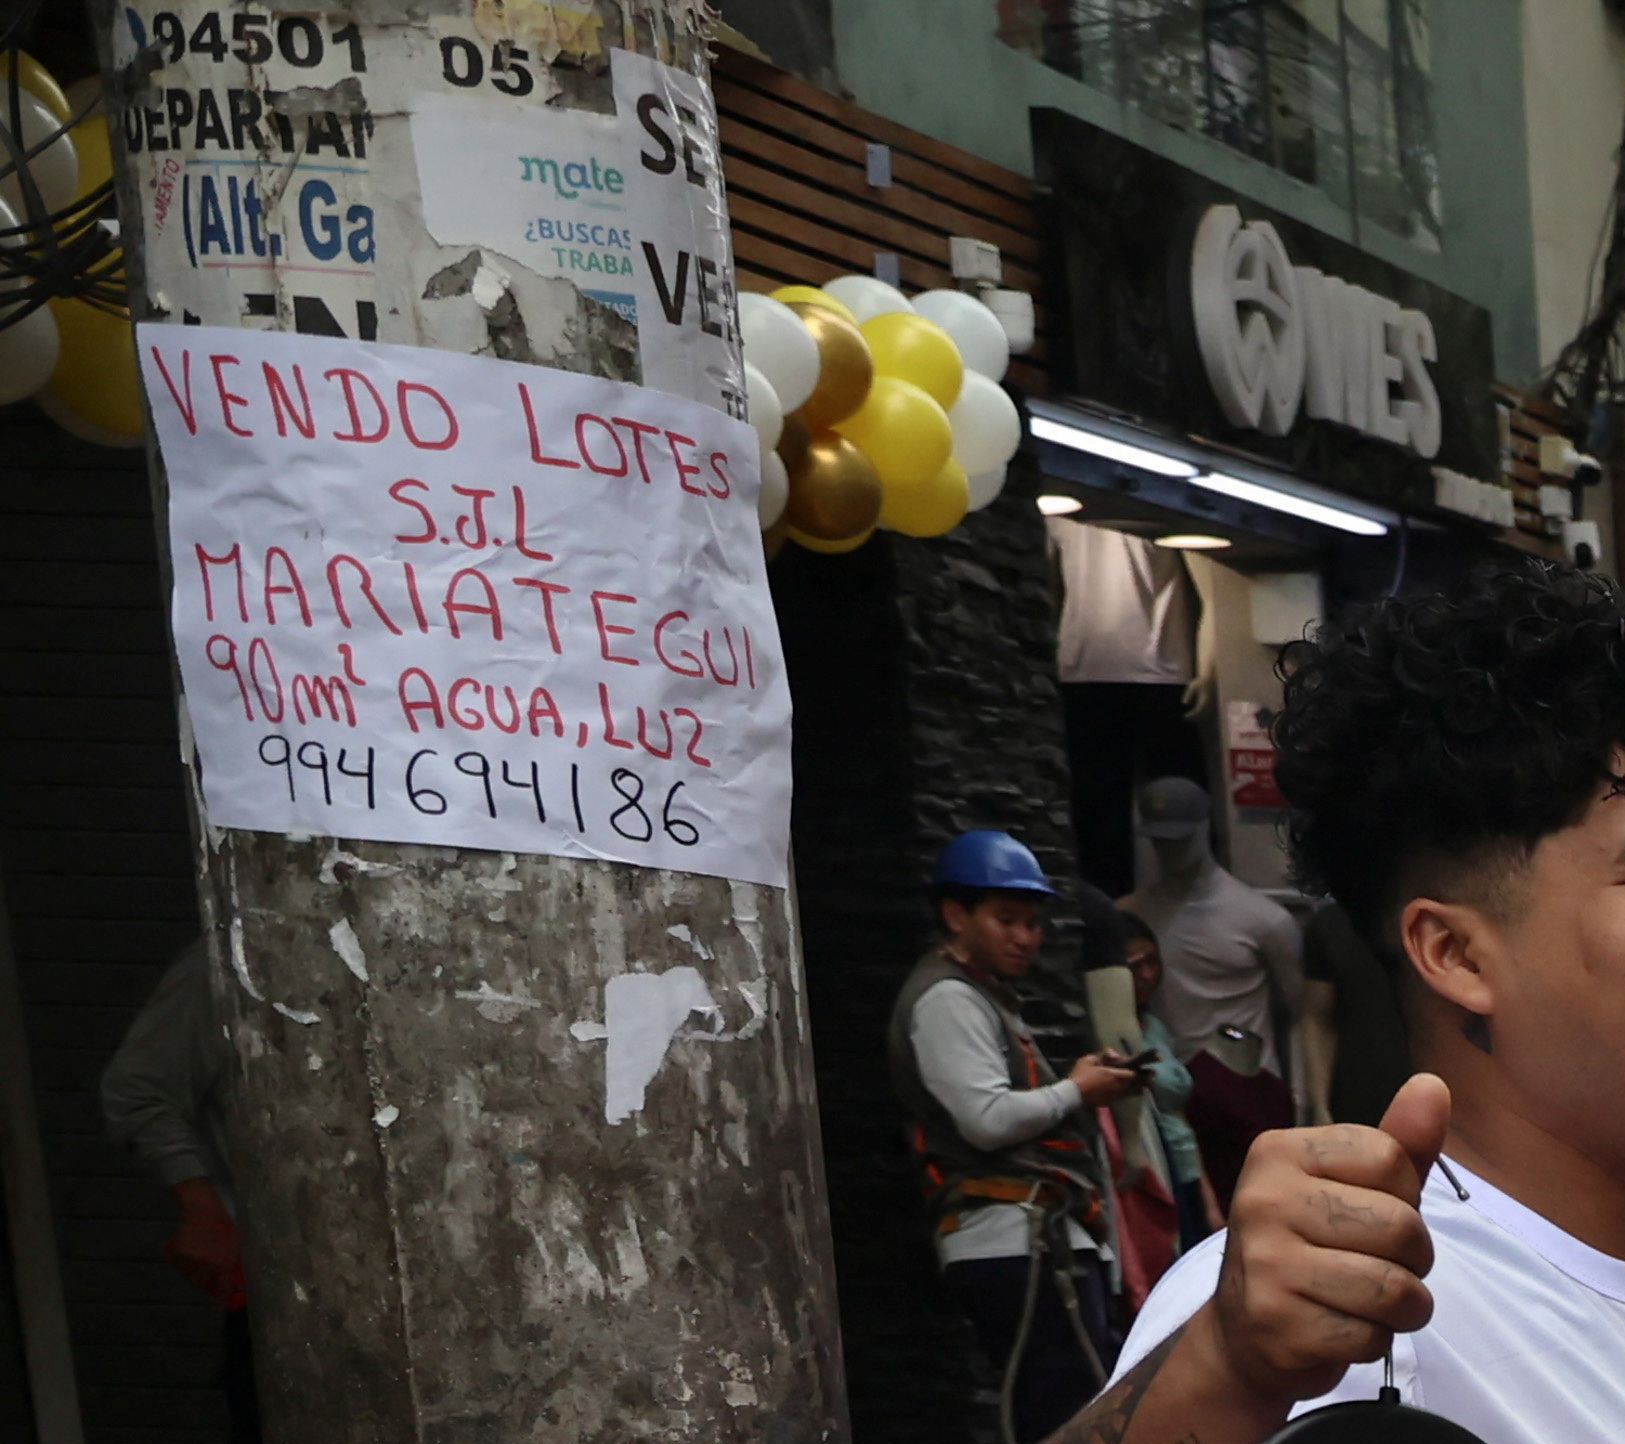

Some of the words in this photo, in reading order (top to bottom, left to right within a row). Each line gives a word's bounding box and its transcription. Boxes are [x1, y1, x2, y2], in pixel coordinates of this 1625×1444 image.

[124, 88, 374, 159] DEPARTA
[152, 346, 459, 451] VENDO
[518, 383, 732, 501] LOTES
[194, 543, 759, 691] MARIATEGUI
